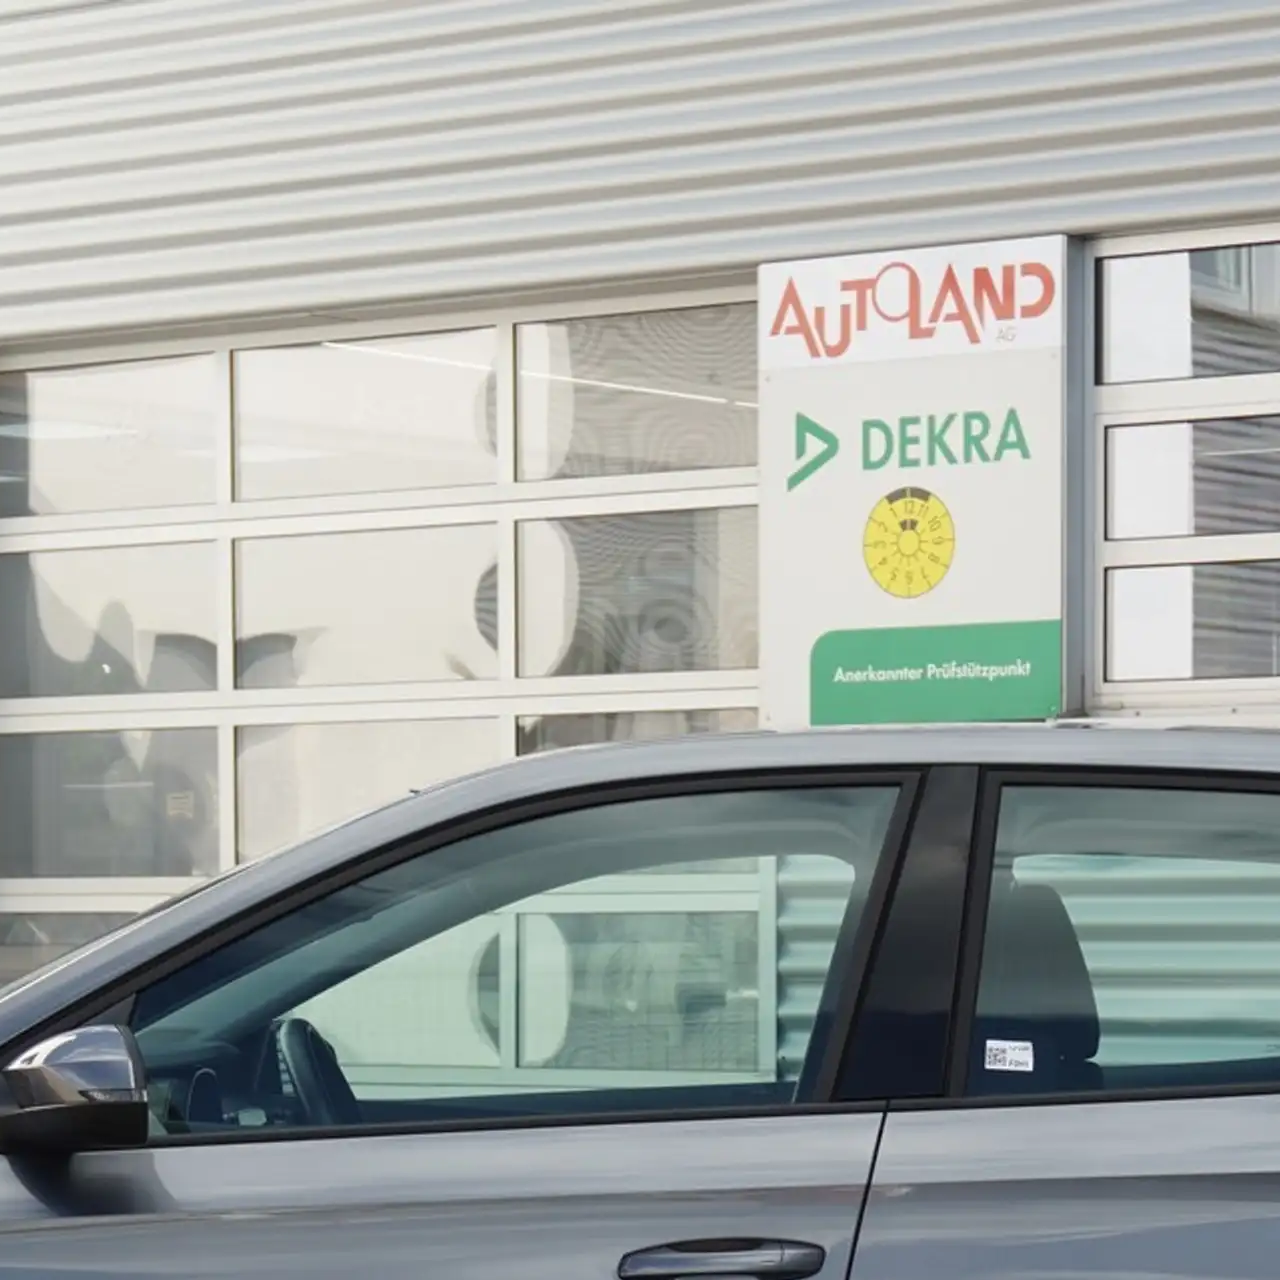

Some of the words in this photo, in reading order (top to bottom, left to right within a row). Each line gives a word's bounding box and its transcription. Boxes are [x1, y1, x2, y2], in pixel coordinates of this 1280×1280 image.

[769, 262, 1055, 358] AUTOLAND
[995, 326, 1017, 343] AG
[862, 408, 1031, 471] DEKRA
[833, 664, 923, 682] Anerkannter
[927, 658, 1031, 682] Prüfstützpunkt
